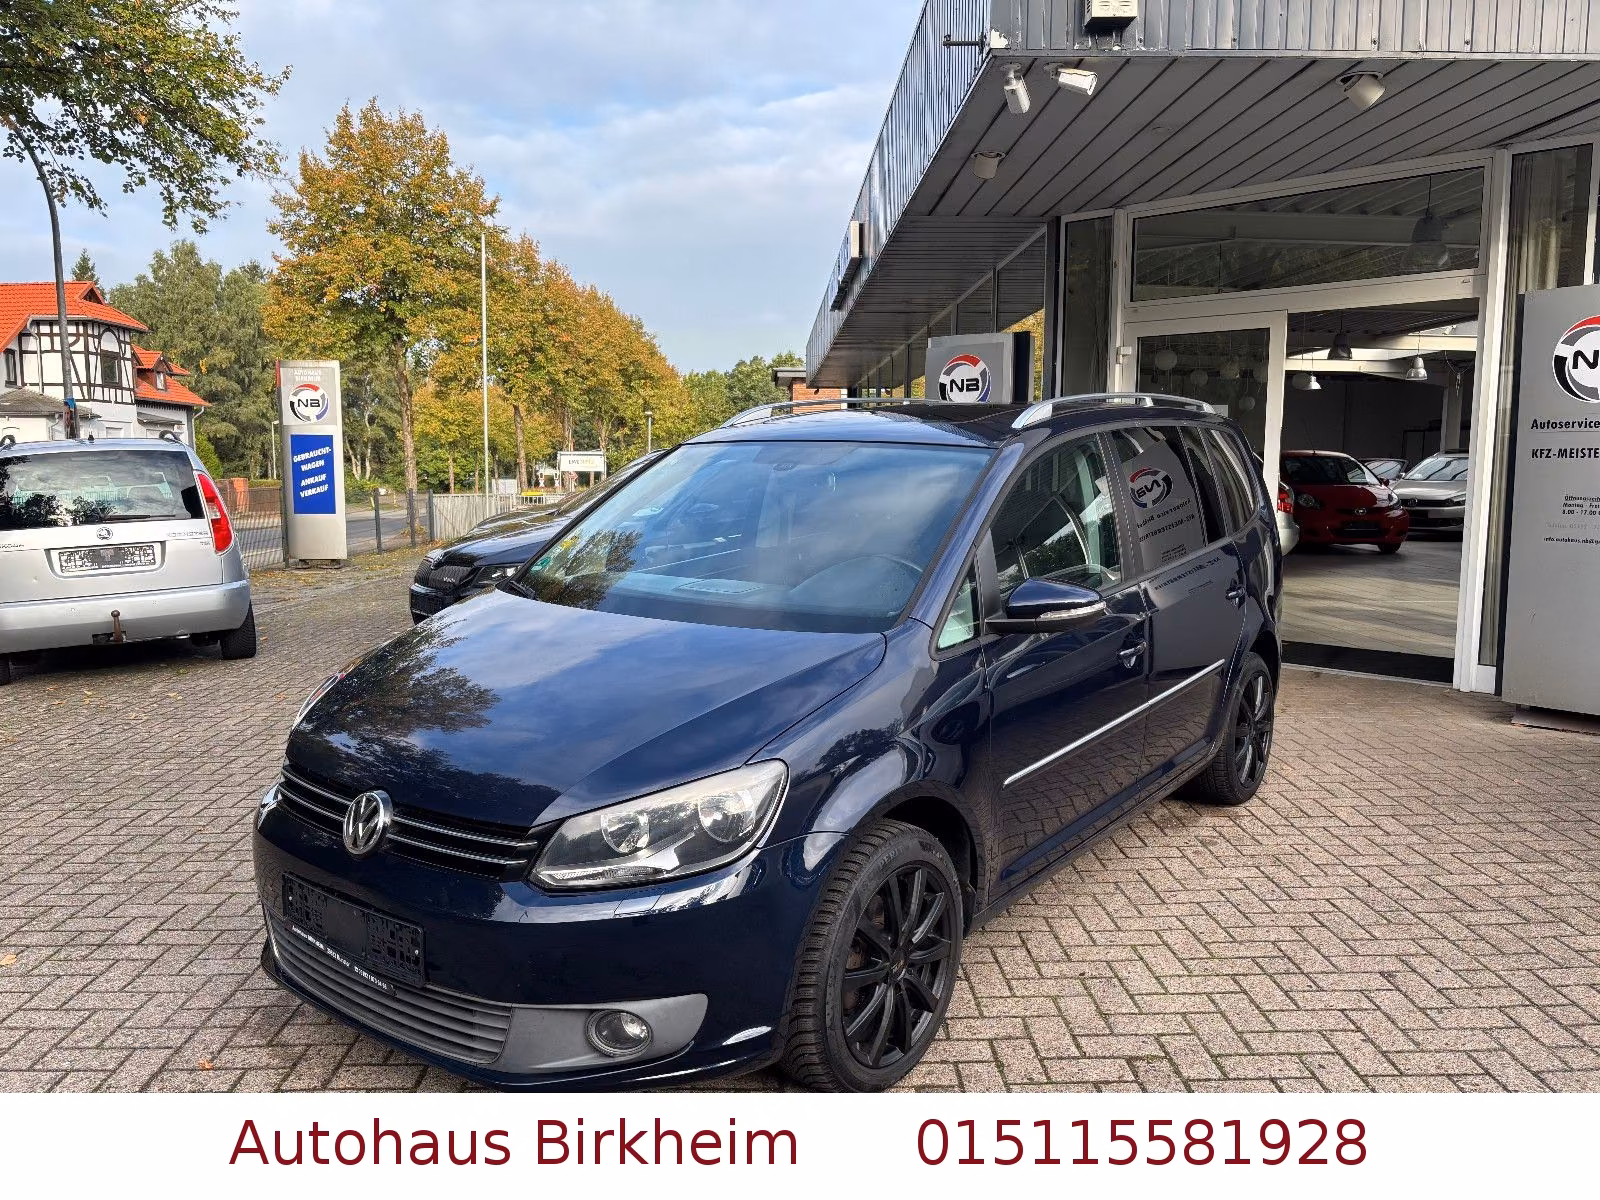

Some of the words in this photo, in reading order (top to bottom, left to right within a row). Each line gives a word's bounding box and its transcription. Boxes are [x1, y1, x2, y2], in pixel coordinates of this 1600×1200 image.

[949, 377, 980, 393] NB
[297, 398, 321, 408] NB
[293, 446, 332, 463] GEBRAUCHT-
[301, 459, 325, 472] WAGEN
[301, 473, 327, 487] ANKAUF
[300, 483, 329, 498] VERKAUF
